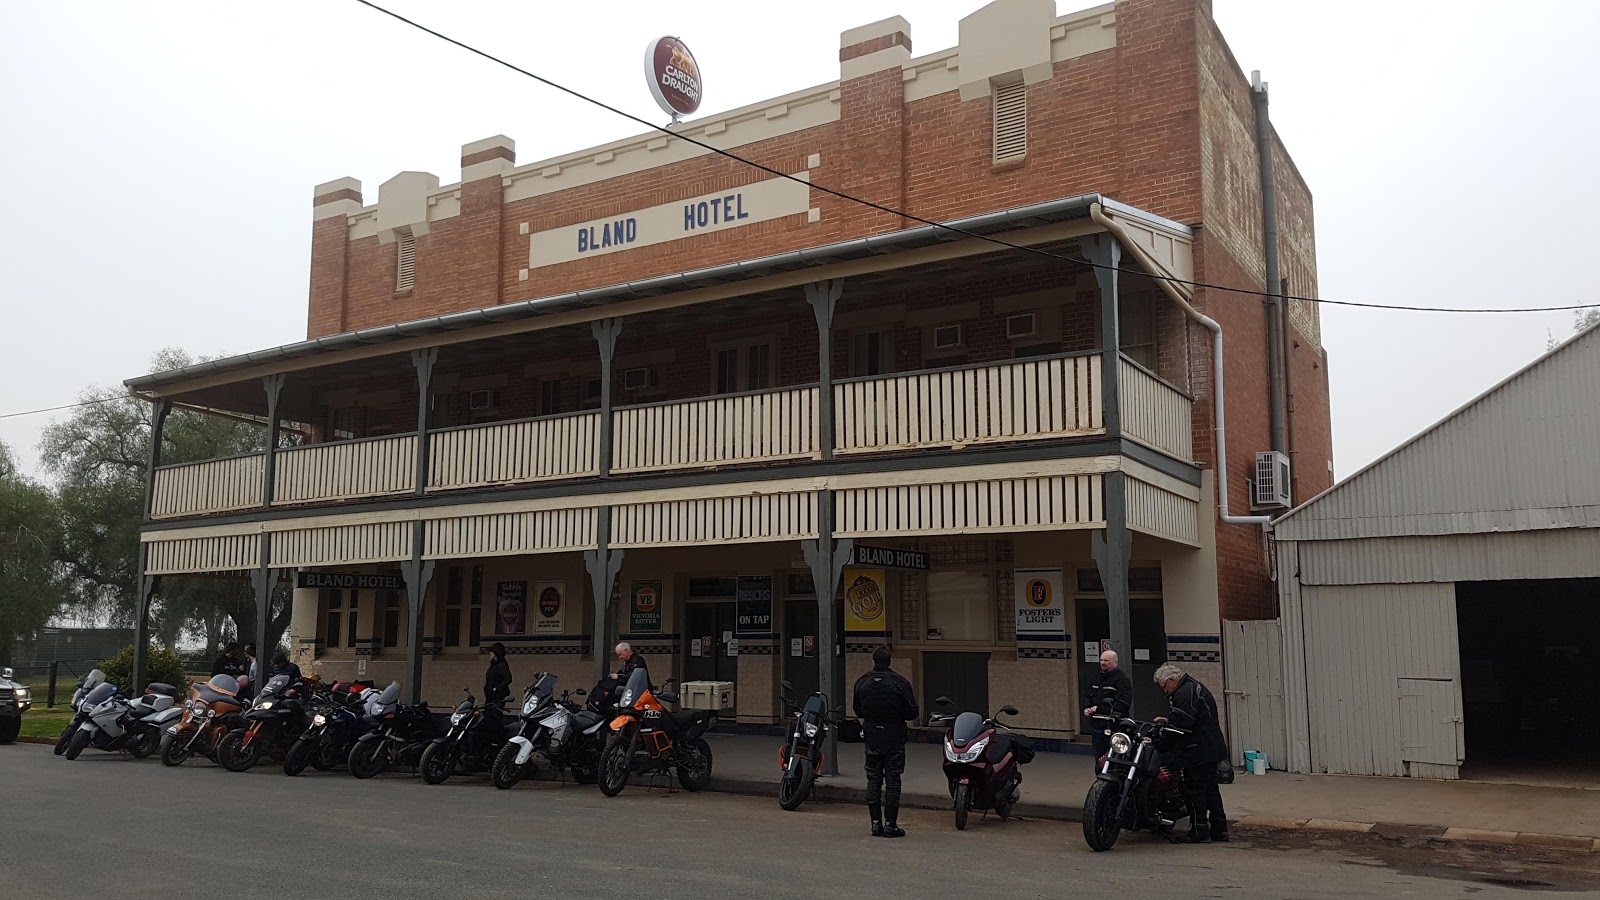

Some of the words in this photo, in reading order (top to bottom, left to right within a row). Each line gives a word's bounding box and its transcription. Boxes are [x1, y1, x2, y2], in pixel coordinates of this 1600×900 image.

[665, 65, 698, 91] CARLTON
[662, 73, 698, 103] DRAUGHT
[578, 218, 636, 253] BLAND
[684, 193, 748, 231] HOTEL
[860, 547, 894, 565] BLAND
[896, 551, 926, 568] HOTEL
[306, 573, 354, 587] BLAND
[358, 575, 400, 588] HOTEL
[640, 595, 652, 604] VB
[1033, 586, 1044, 600] F
[739, 615, 751, 624] ON
[752, 615, 769, 624] TAP
[1019, 608, 1061, 616] FOSTER'S
